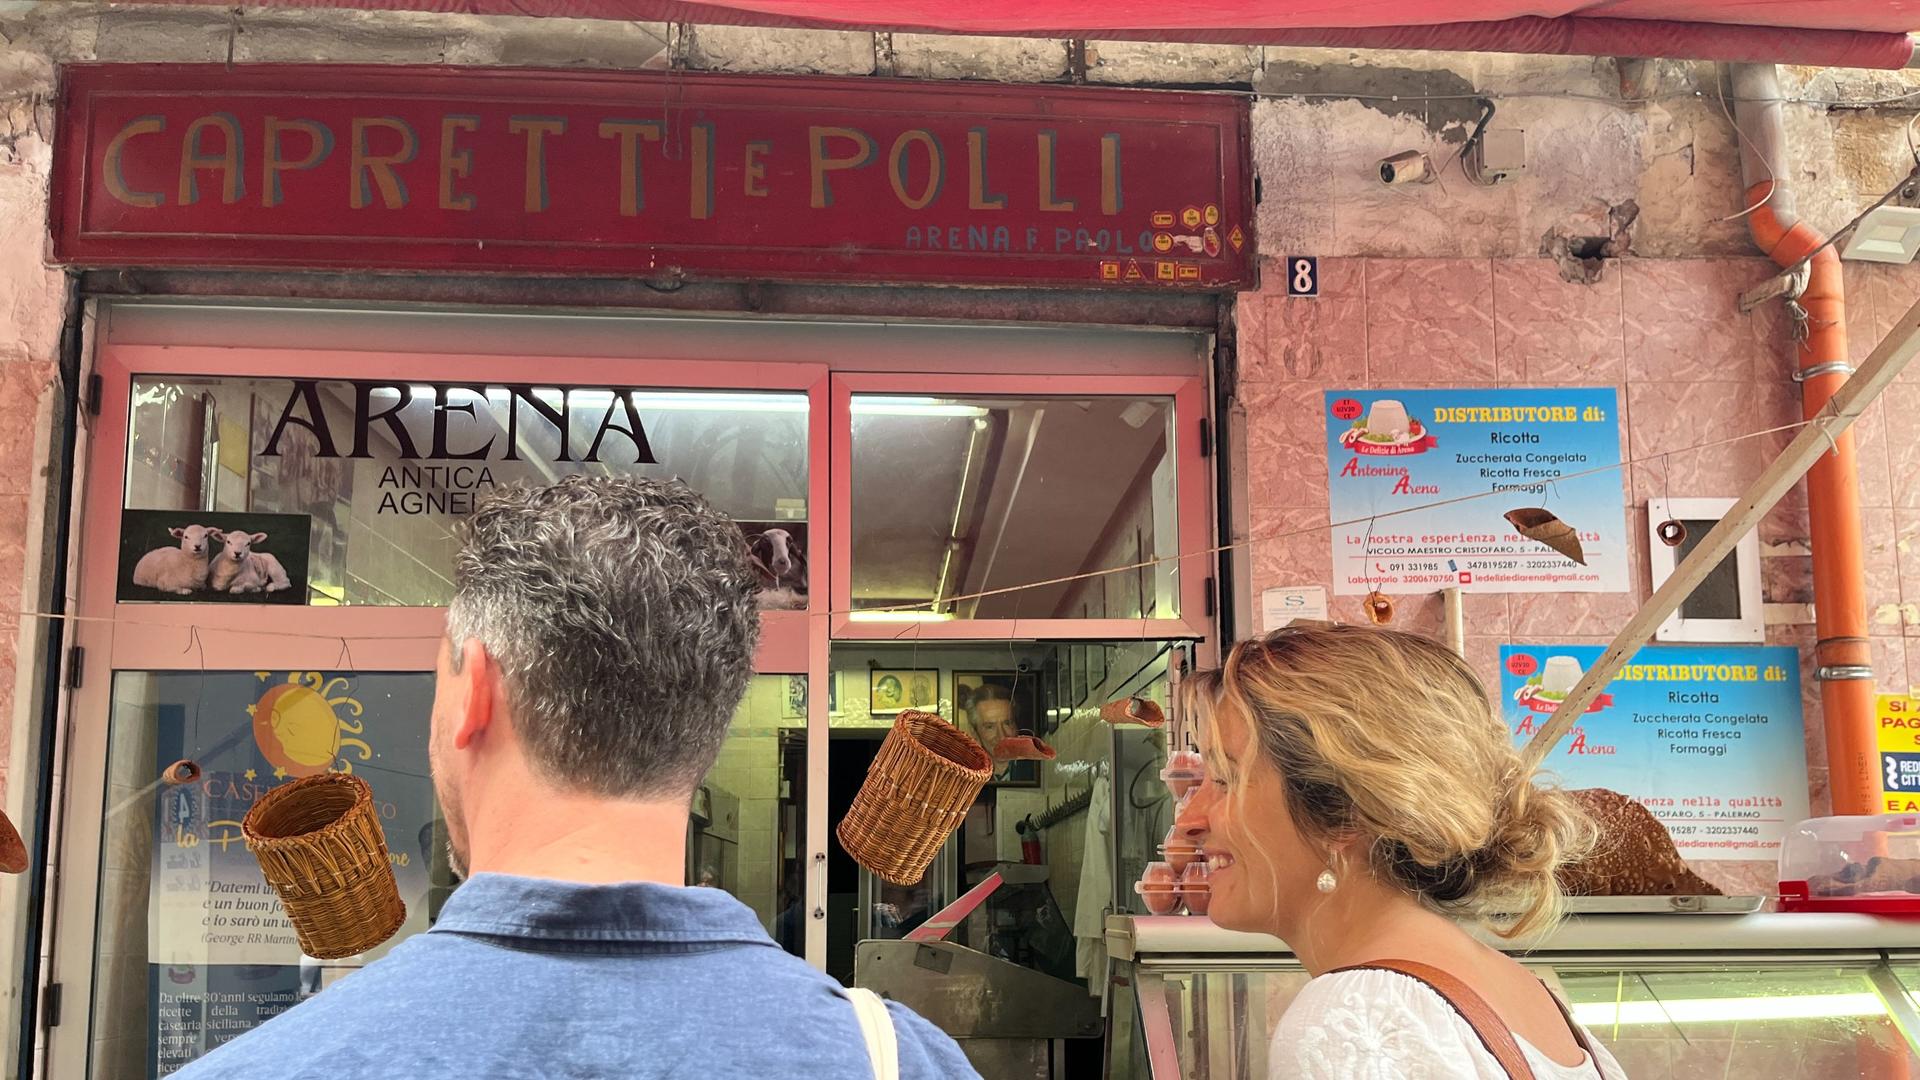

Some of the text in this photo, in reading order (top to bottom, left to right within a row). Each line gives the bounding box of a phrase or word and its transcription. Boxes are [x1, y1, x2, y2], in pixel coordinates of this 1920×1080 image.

[103, 111, 715, 220] CAPRETTI
[809, 124, 1124, 216] POLLI
[906, 225, 1011, 251] ARENA
[1055, 227, 1152, 254] PAOLO
[1292, 260, 1313, 293] 8
[1434, 406, 1606, 423] DISTRIBUTORE di:
[256, 380, 661, 465] ARENA
[1490, 431, 1540, 444] Ricotta
[1455, 452, 1587, 465] Zuccherata Congelata
[1340, 457, 1408, 478] Antonino
[1480, 467, 1561, 478] Ricotta Fresca
[377, 466, 495, 489] ANTICA
[1391, 474, 1440, 495] Arena
[1346, 535, 1361, 545] La
[1368, 534, 1413, 544] nostra
[1421, 532, 1496, 545] esperienza
[1367, 547, 1405, 555] VICOLO
[1389, 562, 1438, 571] 091 331985
[1467, 561, 1518, 569] 3478195287
[1526, 561, 1577, 569] 3202337440
[1347, 574, 1454, 584] Laboratorio 3200670750
[1764, 665, 1787, 682] di:
[1668, 691, 1720, 704] Ricotta
[1889, 701, 1907, 712] SI
[1632, 713, 1769, 726] Zuccherata Congelata
[1657, 728, 1742, 739] Ricotta Fresca
[1567, 734, 1616, 755] Arena
[1670, 743, 1727, 756] Formaggi
[1682, 796, 1721, 807] nella
[1728, 796, 1783, 809] qualità
[1706, 826, 1759, 835] 3202337440
[202, 900, 211, 909] e
[214, 900, 232, 910] un
[236, 897, 269, 911] buon
[201, 916, 210, 926] e
[213, 914, 227, 926] io
[230, 915, 260, 928] sarò
[263, 918, 279, 928] un
[247, 932, 262, 944] RR
[160, 992, 173, 1003] Da
[175, 991, 201, 1003] oltre
[247, 991, 295, 1005] seguiamo
[159, 1006, 192, 1017] ricette
[211, 1005, 238, 1016] della
[159, 1019, 201, 1031] casearia
[158, 1034, 197, 1047] sempre
[158, 1047, 192, 1059] elevati
